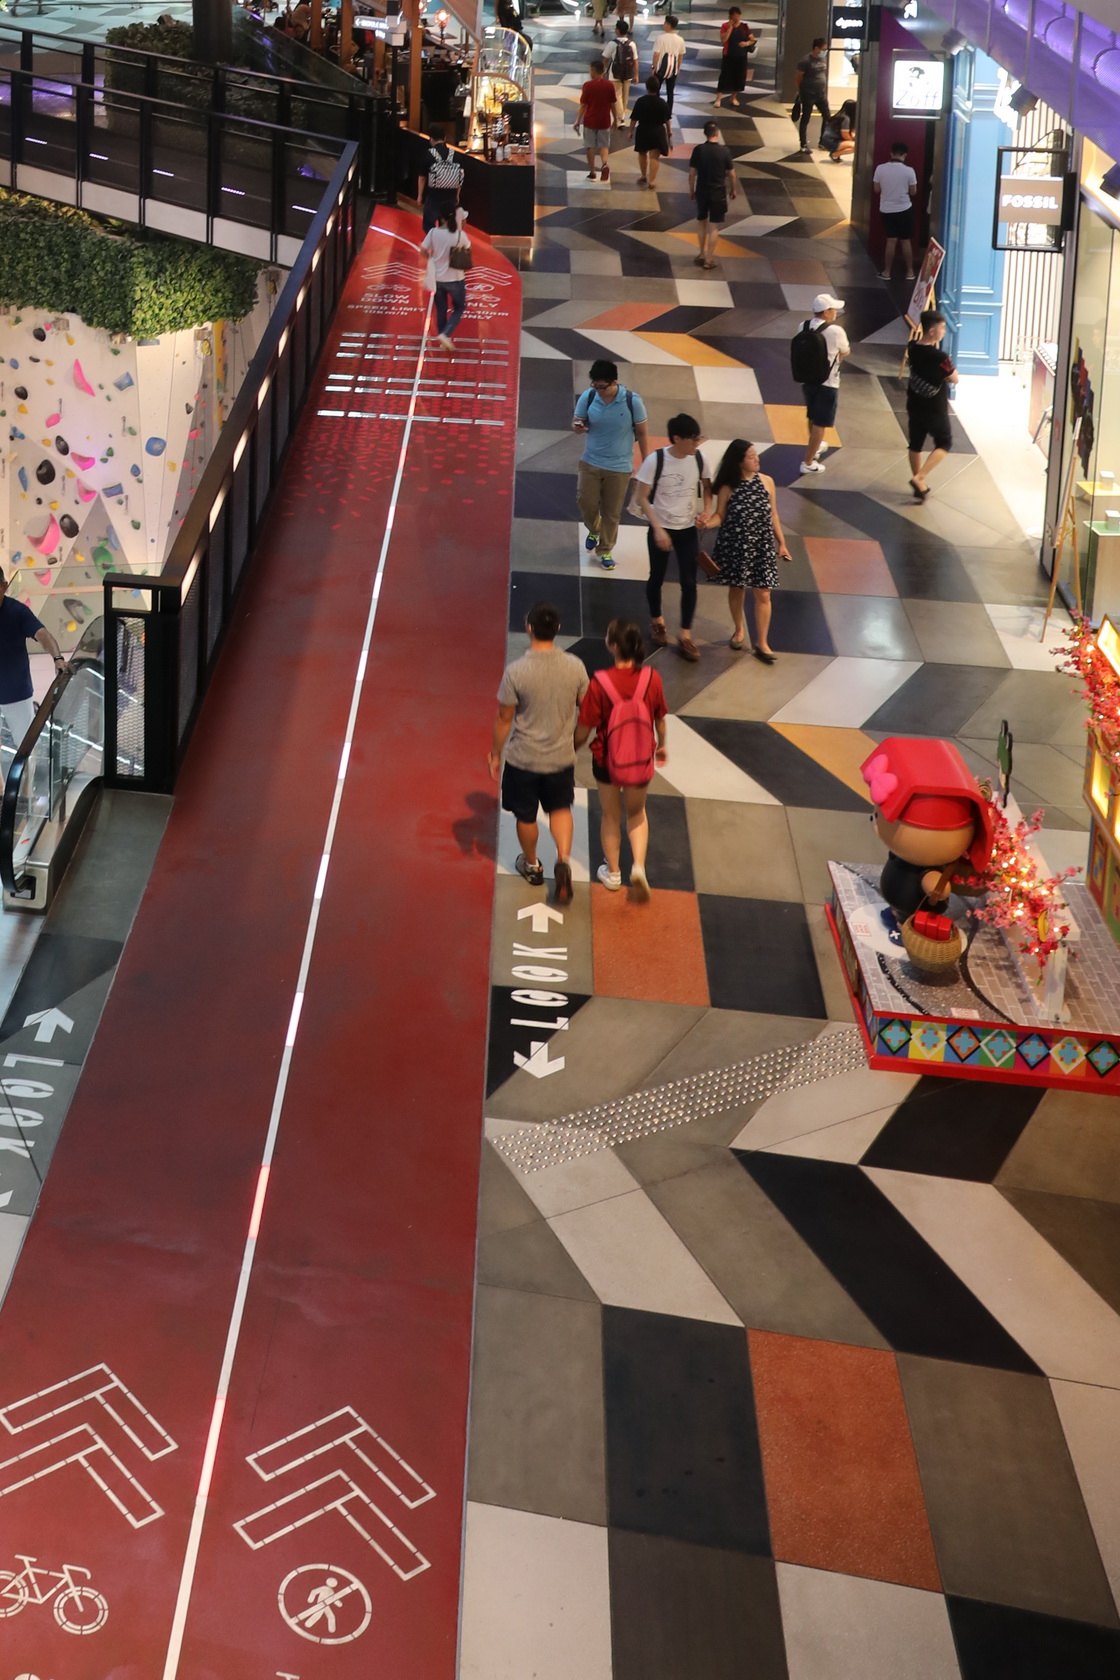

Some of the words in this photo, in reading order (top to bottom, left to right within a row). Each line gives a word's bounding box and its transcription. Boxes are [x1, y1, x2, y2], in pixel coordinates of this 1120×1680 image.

[895, 89, 938, 107] Zoff
[1001, 194, 1059, 209] FOSSIL
[364, 292, 410, 300] SLOW
[512, 942, 569, 1032] LOOK
